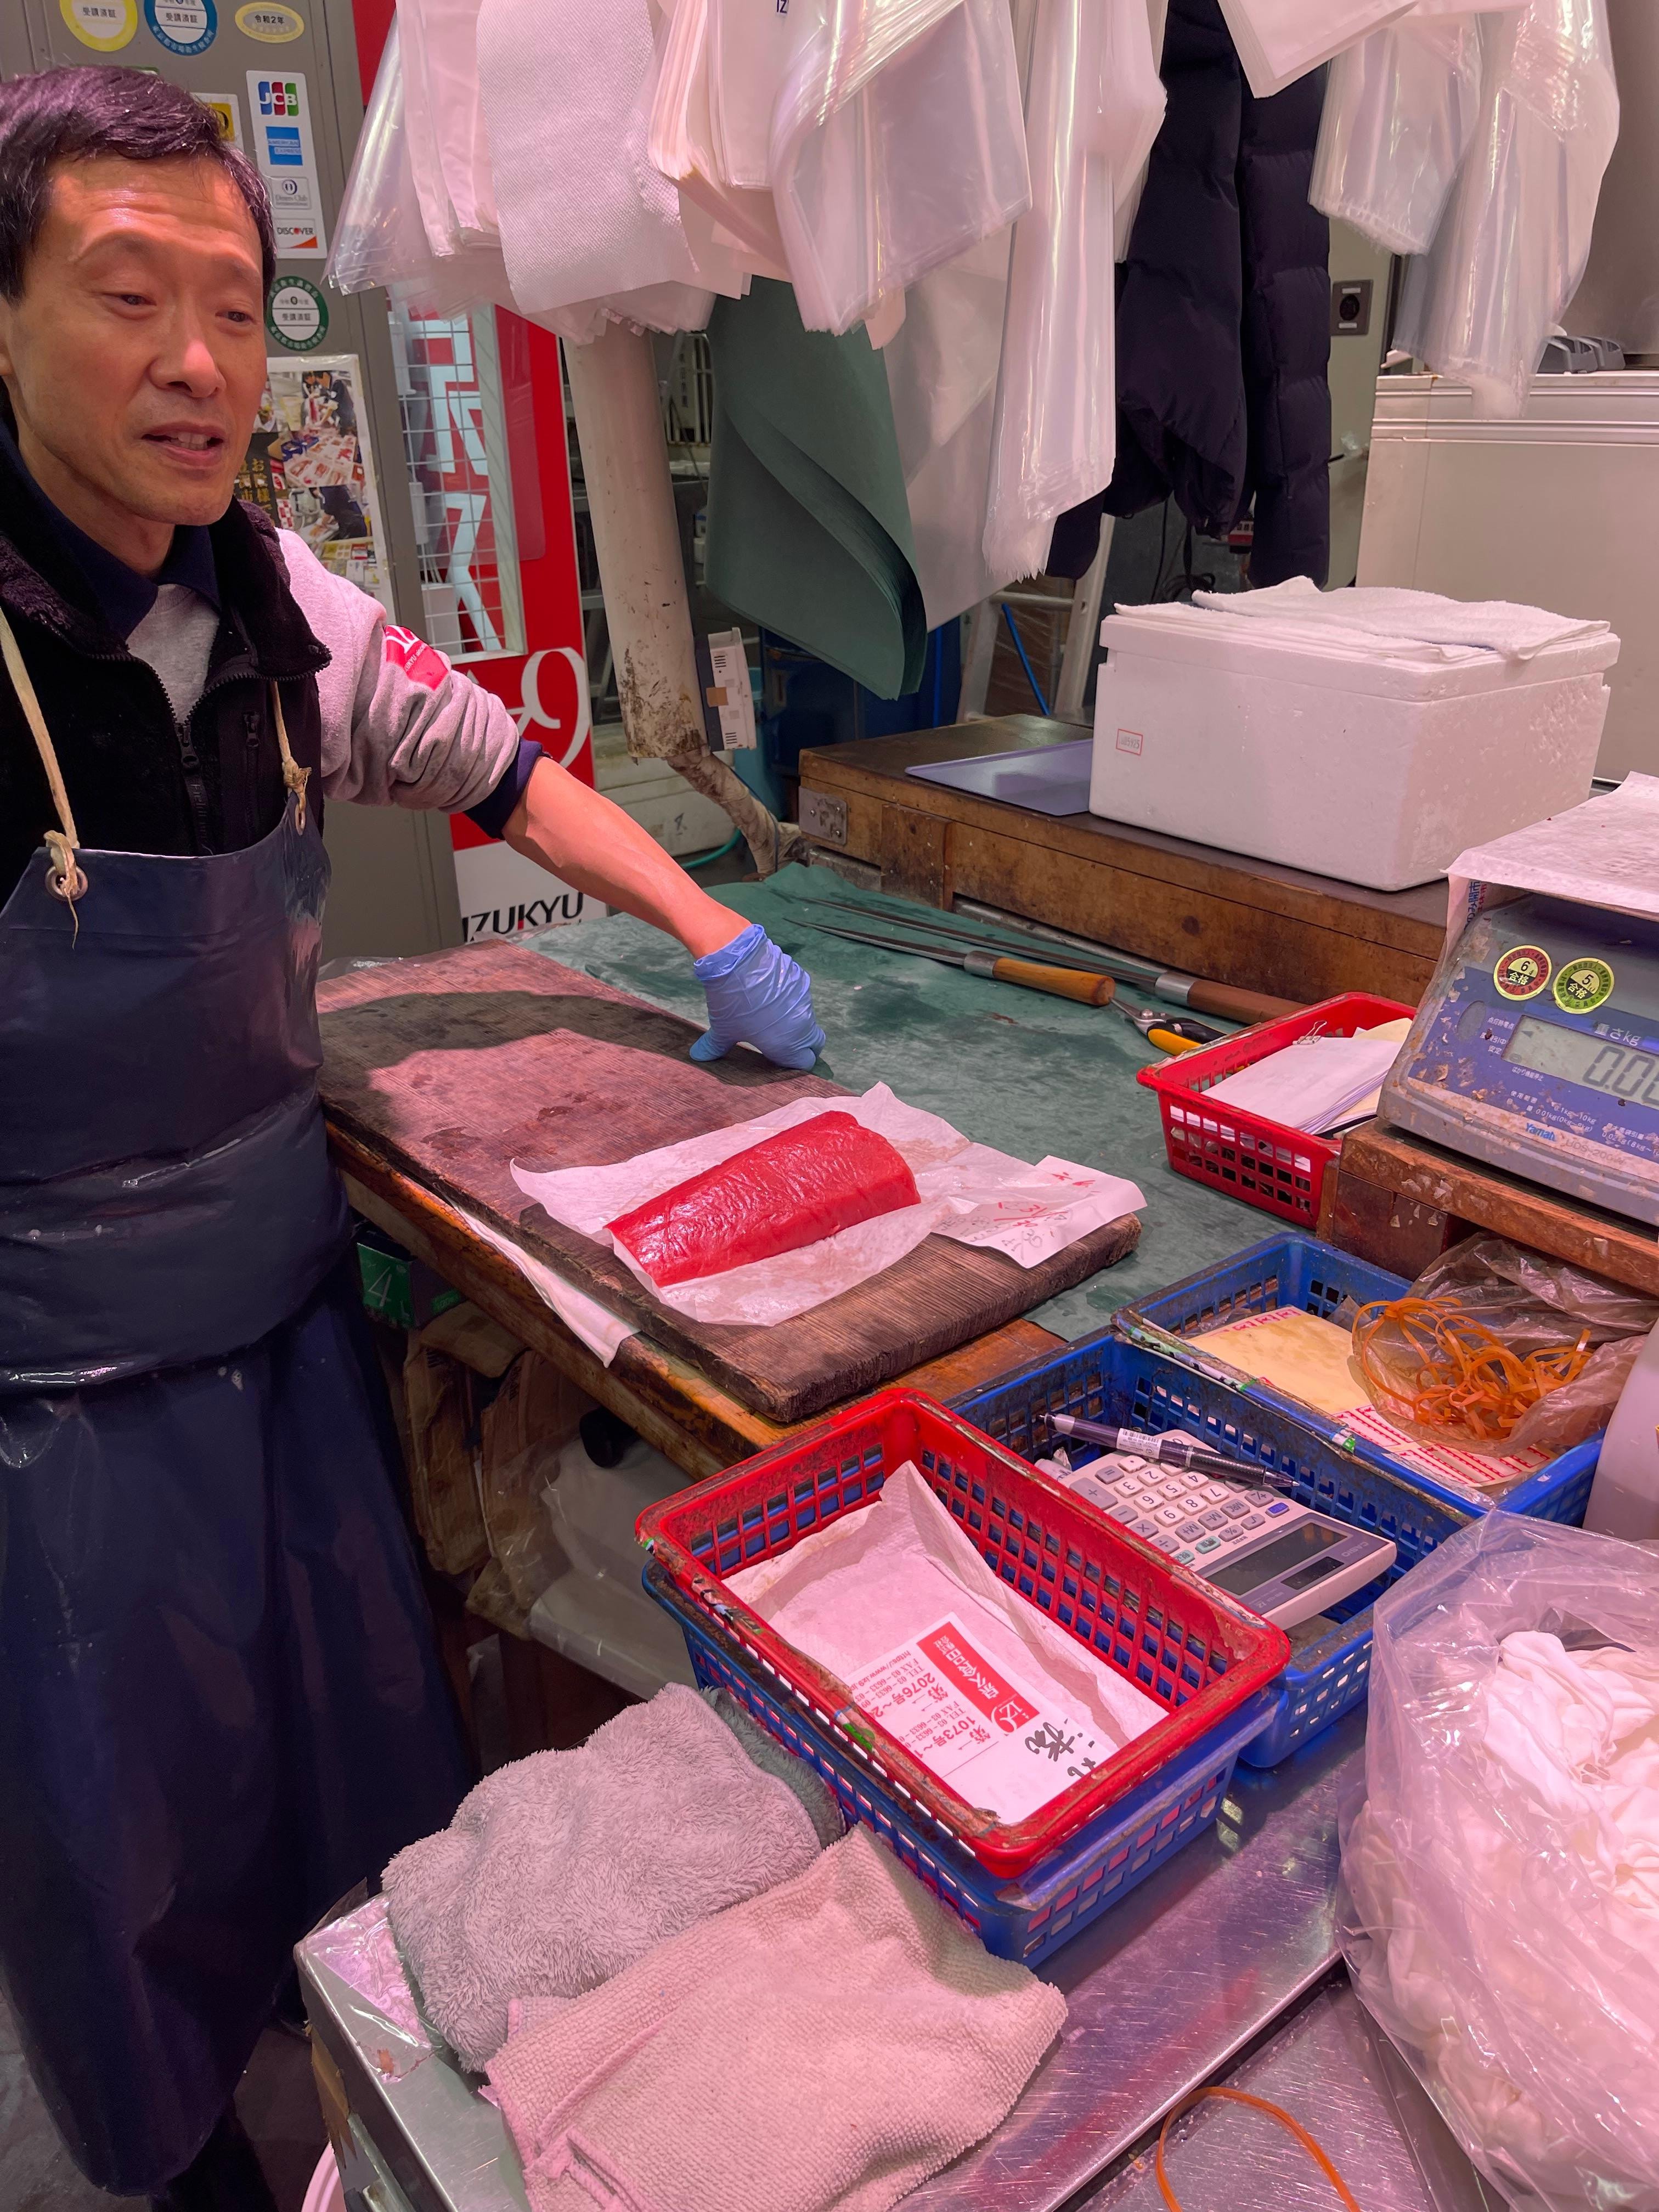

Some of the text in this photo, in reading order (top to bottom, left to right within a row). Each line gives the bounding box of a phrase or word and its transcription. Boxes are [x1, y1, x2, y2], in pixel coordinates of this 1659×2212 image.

[255, 14, 284, 25] 令和2年
[259, 93, 297, 106] JCB
[462, 891, 584, 943] IZUKYU
[1521, 961, 1531, 972] 6
[1509, 972, 1529, 985] 合格
[1582, 974, 1594, 985] 5
[1567, 983, 1587, 999] 合格
[1479, 1031, 1507, 1045] 風引中
[1594, 1023, 1641, 1046] 重さkg
[1488, 1045, 1502, 1055] 安定
[367, 1265, 392, 1307] 4
[1144, 1470, 1159, 1480] 2
[1187, 1475, 1199, 1483] 4
[1122, 1481, 1135, 1491] 3
[1165, 1484, 1178, 1493] 5
[1210, 1488, 1222, 1497] 7
[1142, 1496, 1155, 1505] 6
[1186, 1499, 1198, 1508] 8
[1226, 1501, 1245, 1513] MRC
[1164, 1510, 1176, 1519] 9
[1182, 1523, 1200, 1535] M+
[1341, 1542, 1369, 1558] CASIO
[907, 1666, 925, 1678] TEL
[945, 1648, 999, 1700] 泉久食品
[854, 1658, 919, 1702] FAX 03-6633-03
[940, 1701, 960, 1716] FAX
[947, 1708, 966, 1720] TEL
[958, 1724, 991, 1750] 第一
